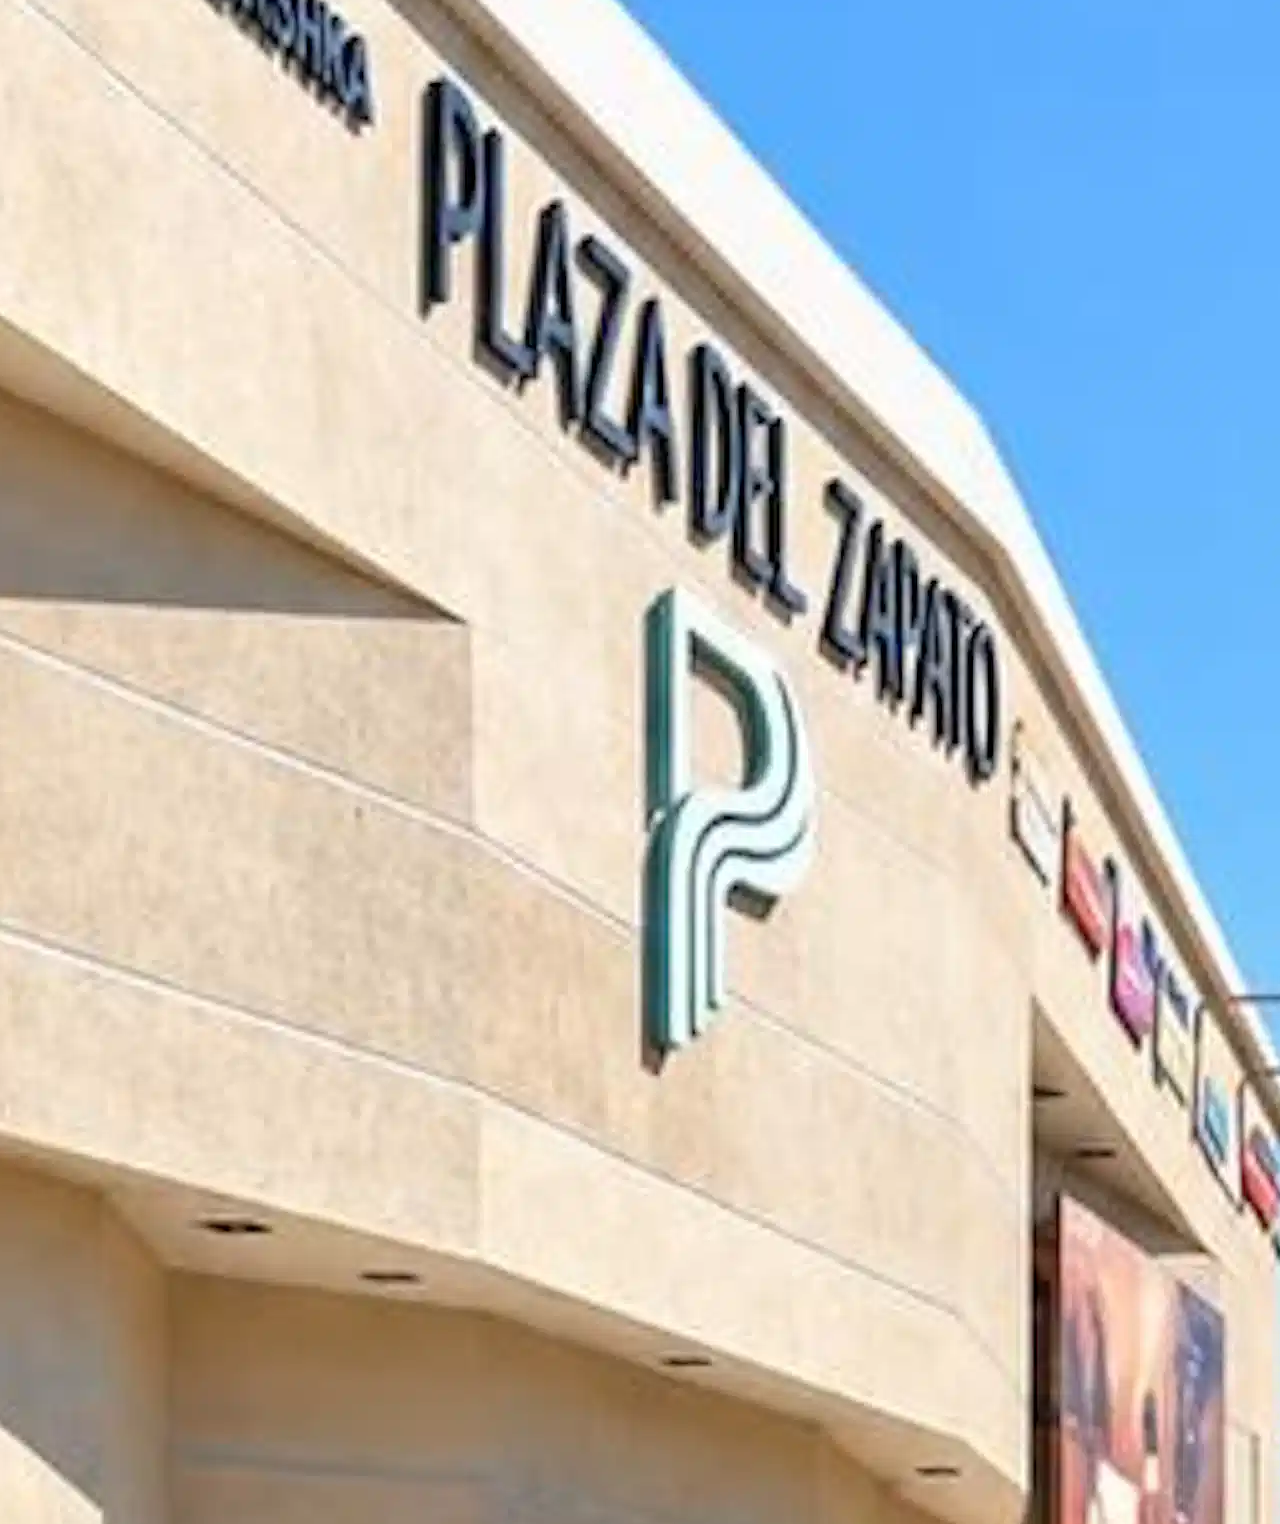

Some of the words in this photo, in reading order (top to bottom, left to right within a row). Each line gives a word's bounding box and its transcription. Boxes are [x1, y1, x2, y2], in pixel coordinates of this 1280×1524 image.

[422, 77, 678, 503] PLAZA
[689, 344, 807, 615] DEL
[822, 478, 999, 780] ZAPATO
